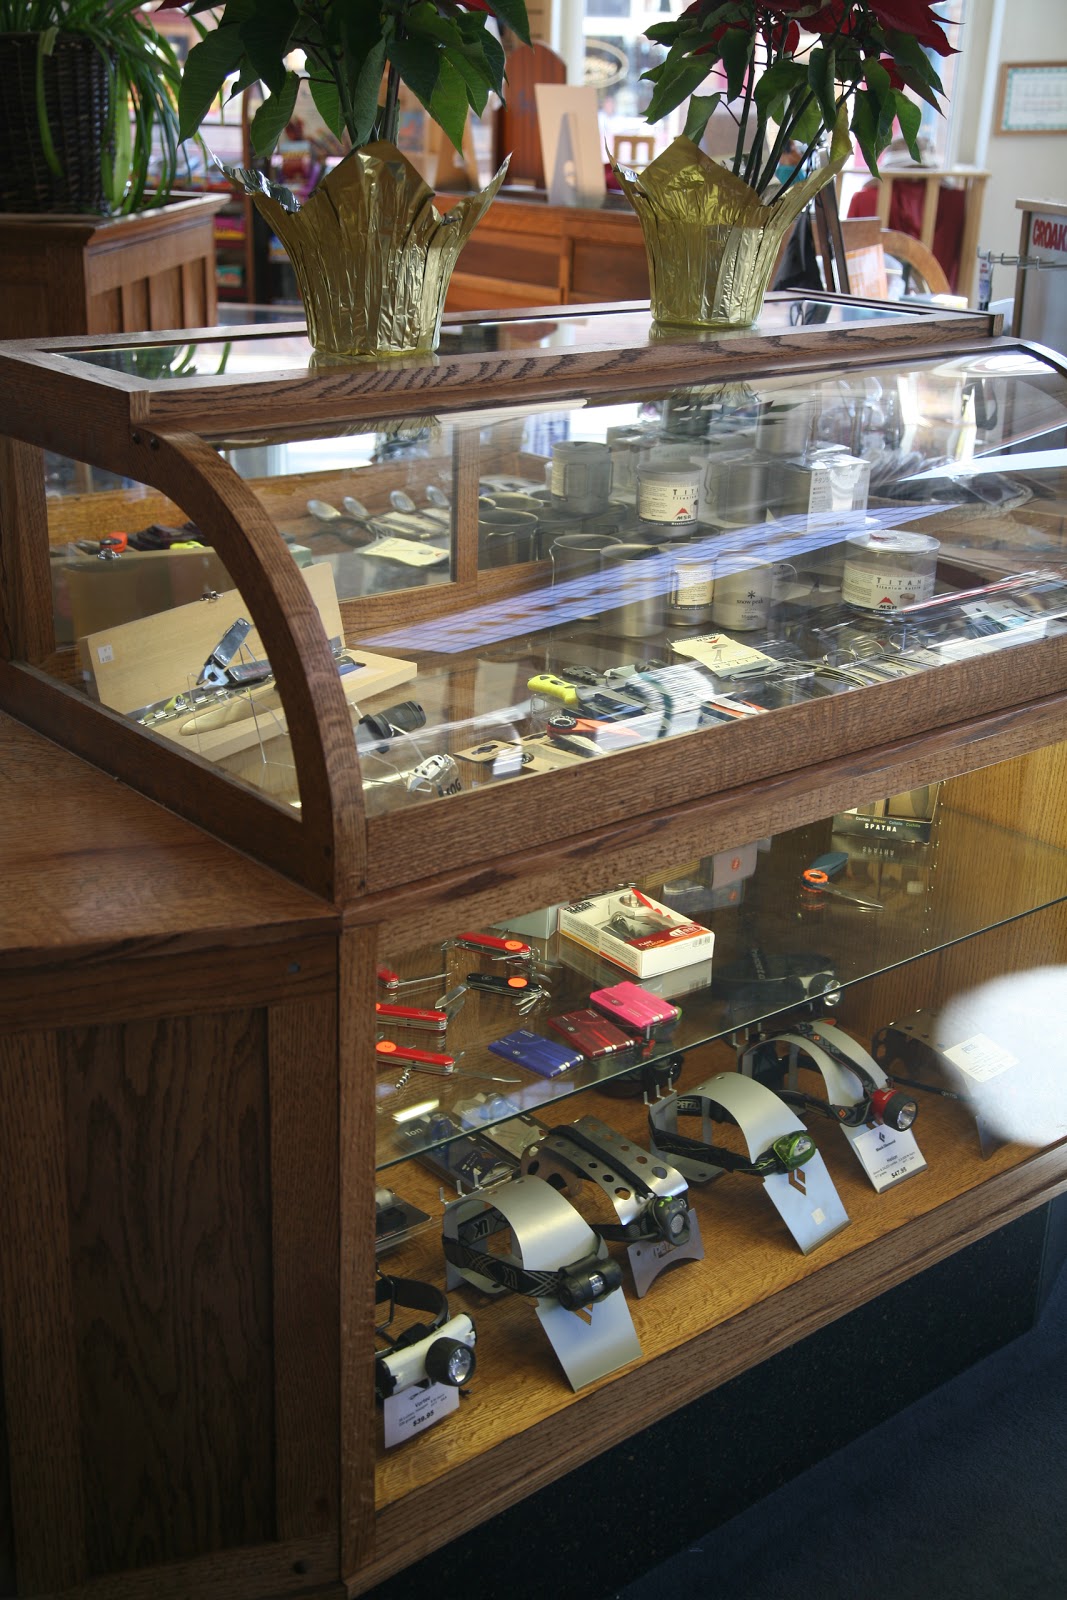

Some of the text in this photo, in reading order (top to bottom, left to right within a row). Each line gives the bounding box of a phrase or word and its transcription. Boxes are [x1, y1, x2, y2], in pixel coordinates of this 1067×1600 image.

[876, 577, 921, 586] TITAN
[751, 597, 763, 606] peak
[864, 822, 897, 832] SPATHA
[413, 1410, 434, 1427] $39.95
